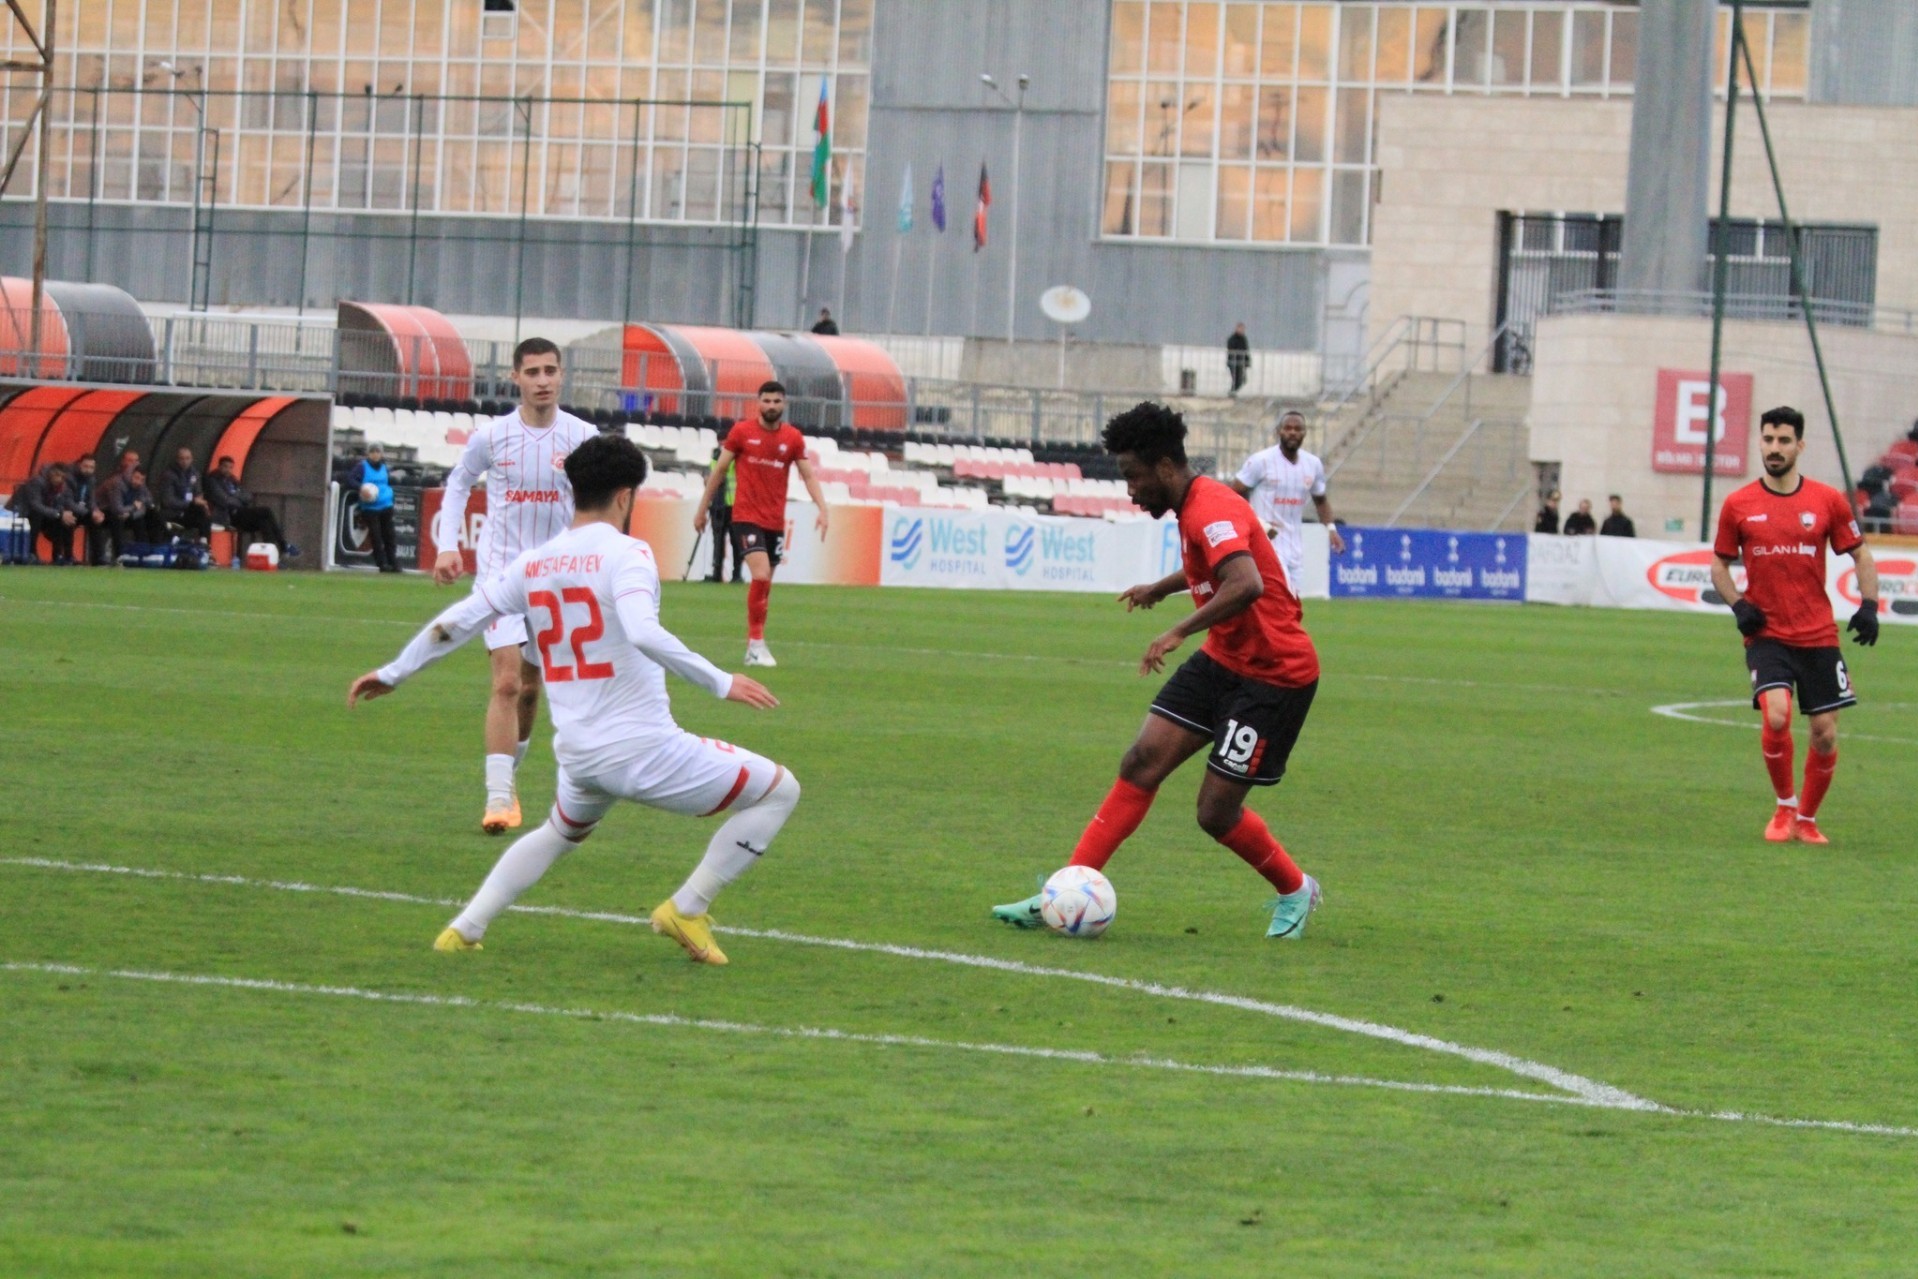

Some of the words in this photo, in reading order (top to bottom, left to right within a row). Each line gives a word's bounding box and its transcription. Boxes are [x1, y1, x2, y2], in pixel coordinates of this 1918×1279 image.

[1676, 380, 1727, 445] B
[505, 489, 559, 503] SAMAYA
[930, 518, 987, 555] West
[1041, 525, 1095, 562] West
[1753, 545, 1791, 557] GILAN
[931, 559, 986, 575] HOSPITAL
[1042, 567, 1095, 582] HOSPITAL
[528, 586, 615, 683] 22
[1836, 660, 1847, 690] 6
[1219, 719, 1258, 763] 19
